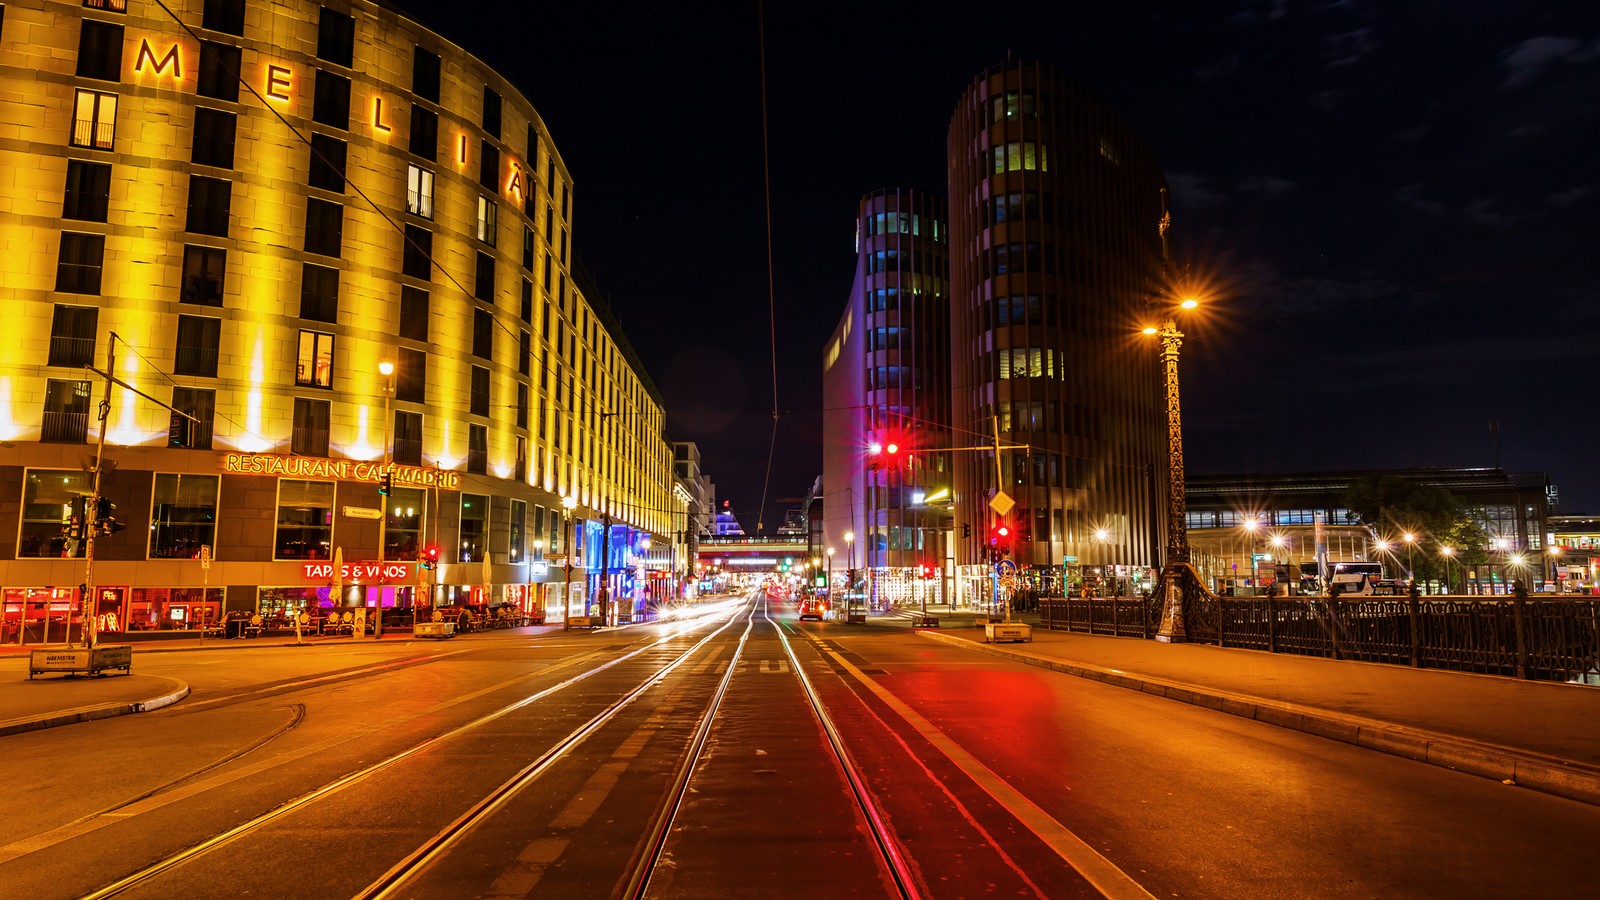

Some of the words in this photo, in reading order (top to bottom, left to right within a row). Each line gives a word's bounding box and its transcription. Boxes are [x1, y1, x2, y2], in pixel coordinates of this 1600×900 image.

[226, 453, 351, 478] RESTAURANT
[396, 467, 459, 488] MADRID
[304, 565, 349, 577] TAPS
[352, 566, 363, 577] &
[366, 566, 406, 577] VINOS
